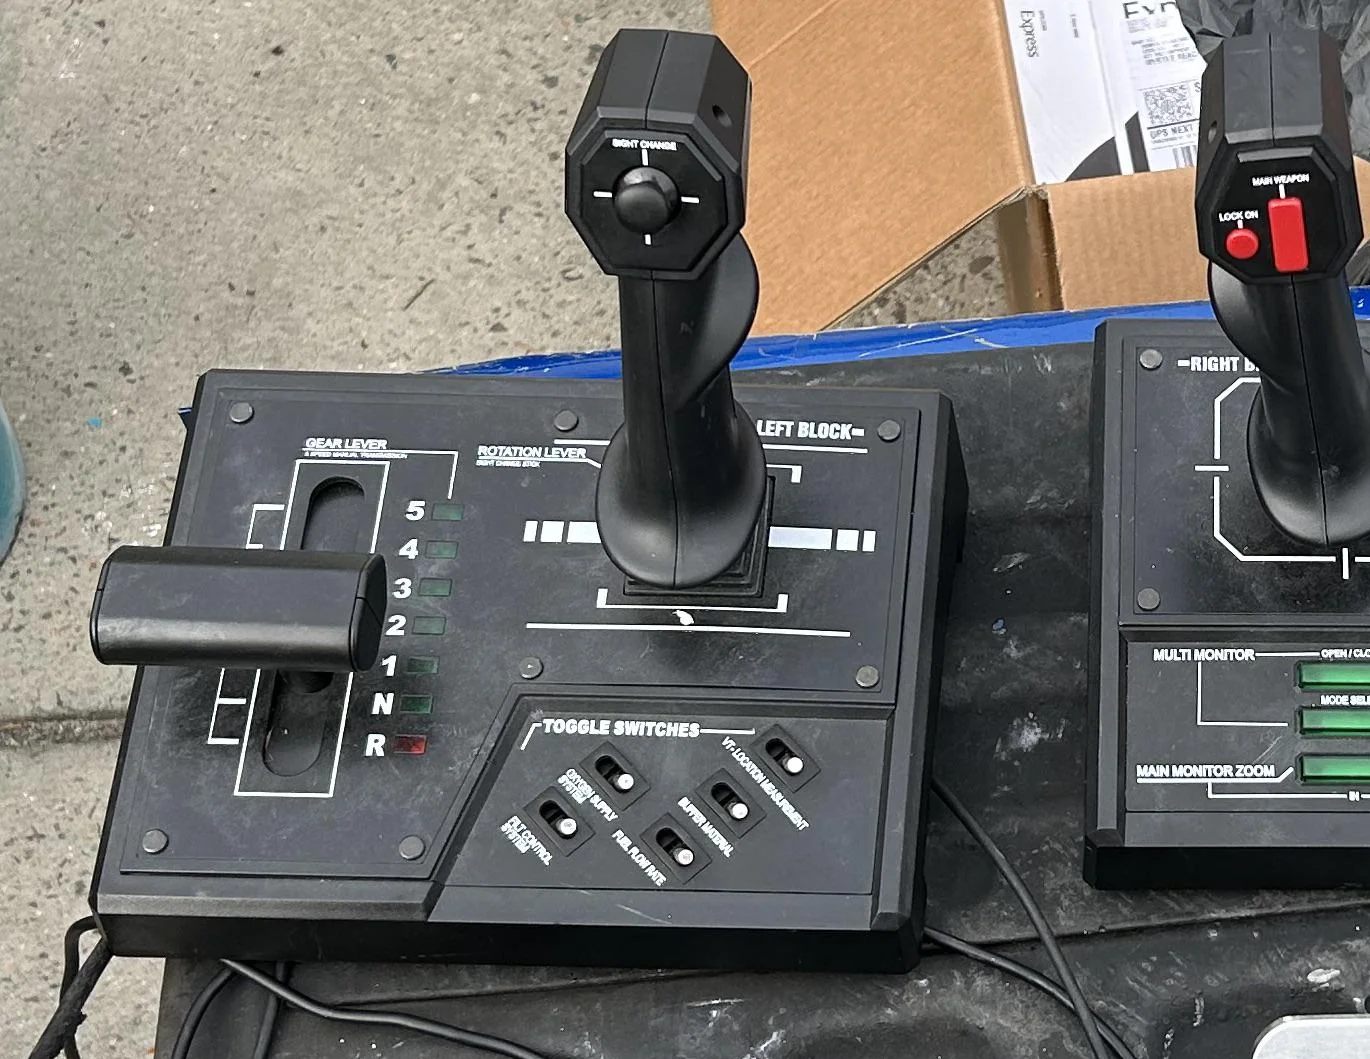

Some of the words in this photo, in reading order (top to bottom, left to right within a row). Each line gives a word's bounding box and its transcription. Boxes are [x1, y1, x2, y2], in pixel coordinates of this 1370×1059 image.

[1019, 10, 1040, 58] Express
[1252, 176, 1273, 187] MAIN
[1273, 173, 1310, 185] WEAPON
[1218, 211, 1243, 222] LOCK
[1244, 210, 1259, 220] ON
[756, 420, 794, 437] LEFT
[305, 437, 343, 449] GEAR
[344, 438, 388, 450] LEVER
[477, 445, 542, 458] ROTATION
[543, 446, 587, 459] LEVER
[405, 500, 426, 521] 5
[398, 538, 419, 560] 4
[393, 577, 412, 599] 3
[385, 614, 407, 636] 2
[1153, 648, 1192, 661] MULTI
[1193, 648, 1256, 661] MONITOR
[1320, 648, 1347, 658] OPEN
[381, 654, 397, 677] 1
[371, 692, 395, 715] N
[1320, 695, 1350, 705] MODE
[542, 718, 611, 735] TOGGLE
[613, 720, 701, 738] SWITCHES
[365, 733, 386, 757] R
[1136, 764, 1171, 777] MAIN
[1171, 764, 1234, 778] MONITOR
[1234, 764, 1276, 778] ZOOM
